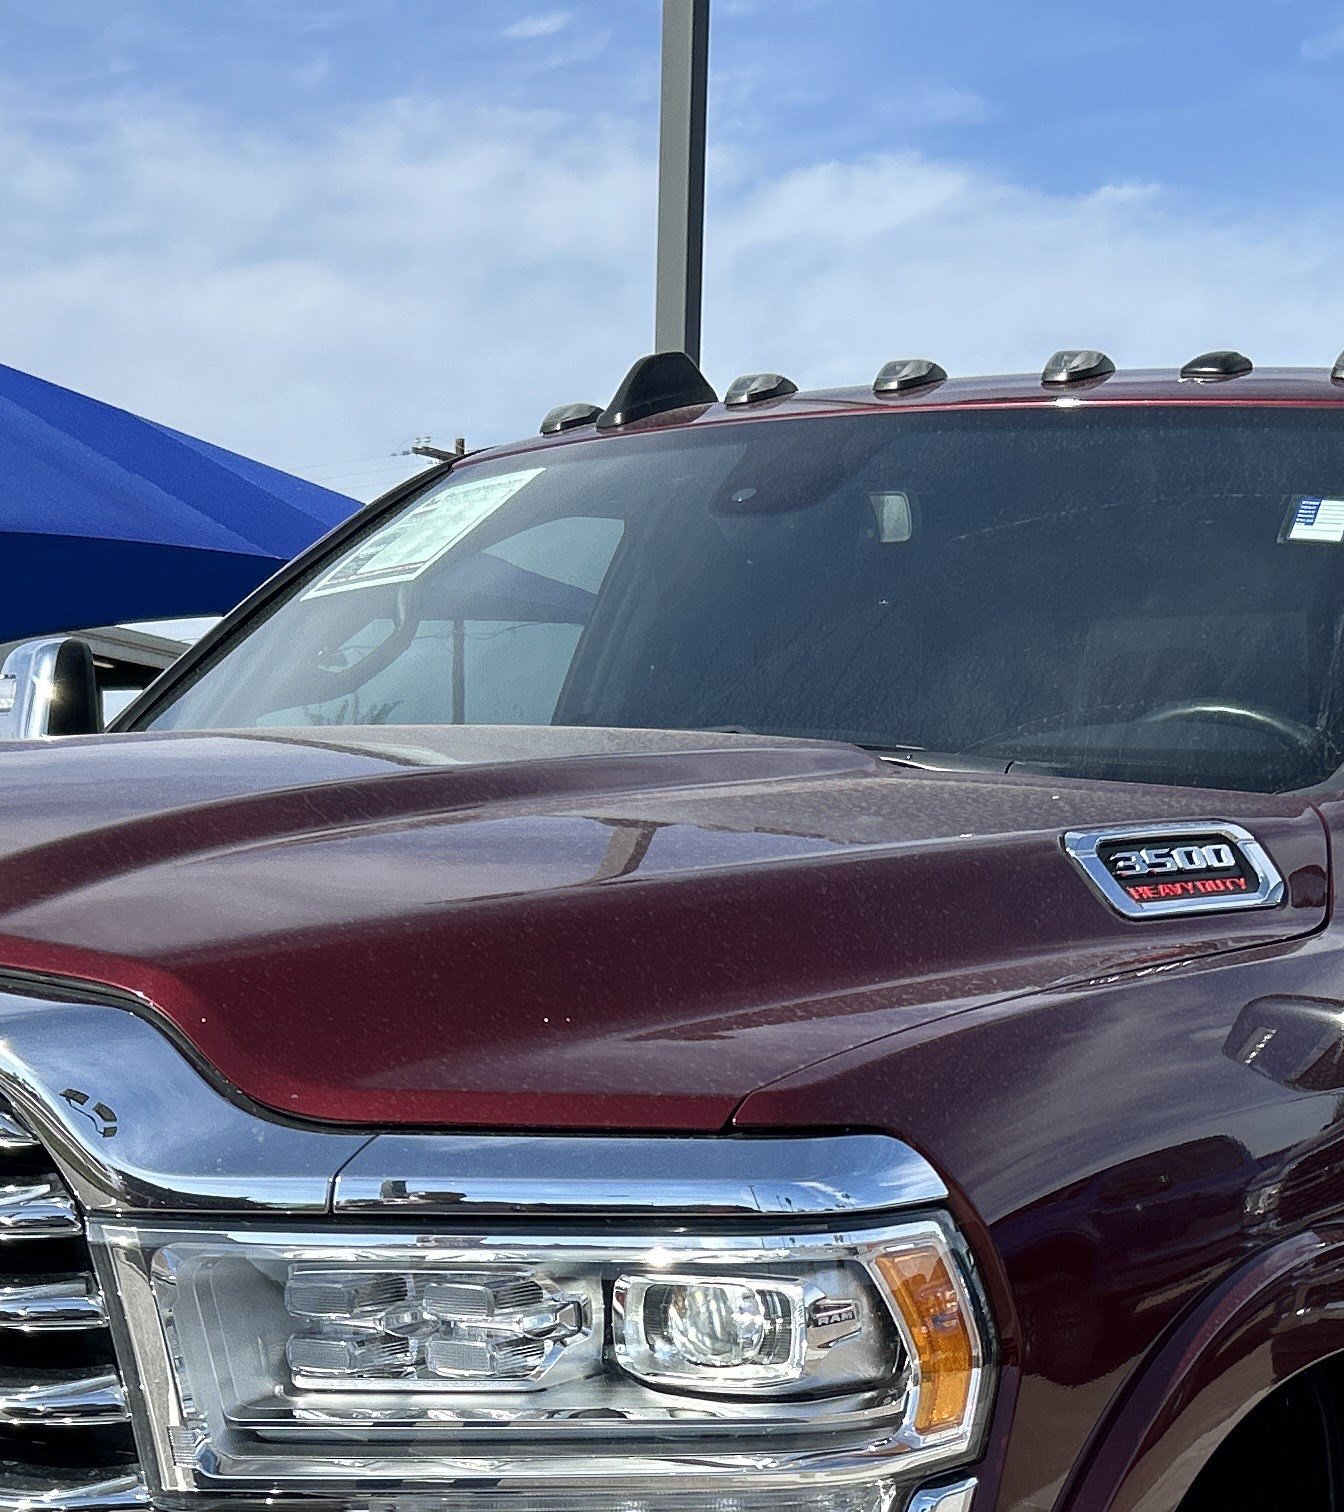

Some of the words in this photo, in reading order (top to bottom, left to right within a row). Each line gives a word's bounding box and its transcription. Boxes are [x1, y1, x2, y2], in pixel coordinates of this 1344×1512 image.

[1110, 844, 1236, 876] 3500
[1126, 881, 1196, 900] HEAVY
[1195, 877, 1247, 893] DUTY
[817, 1309, 855, 1327] RAM
